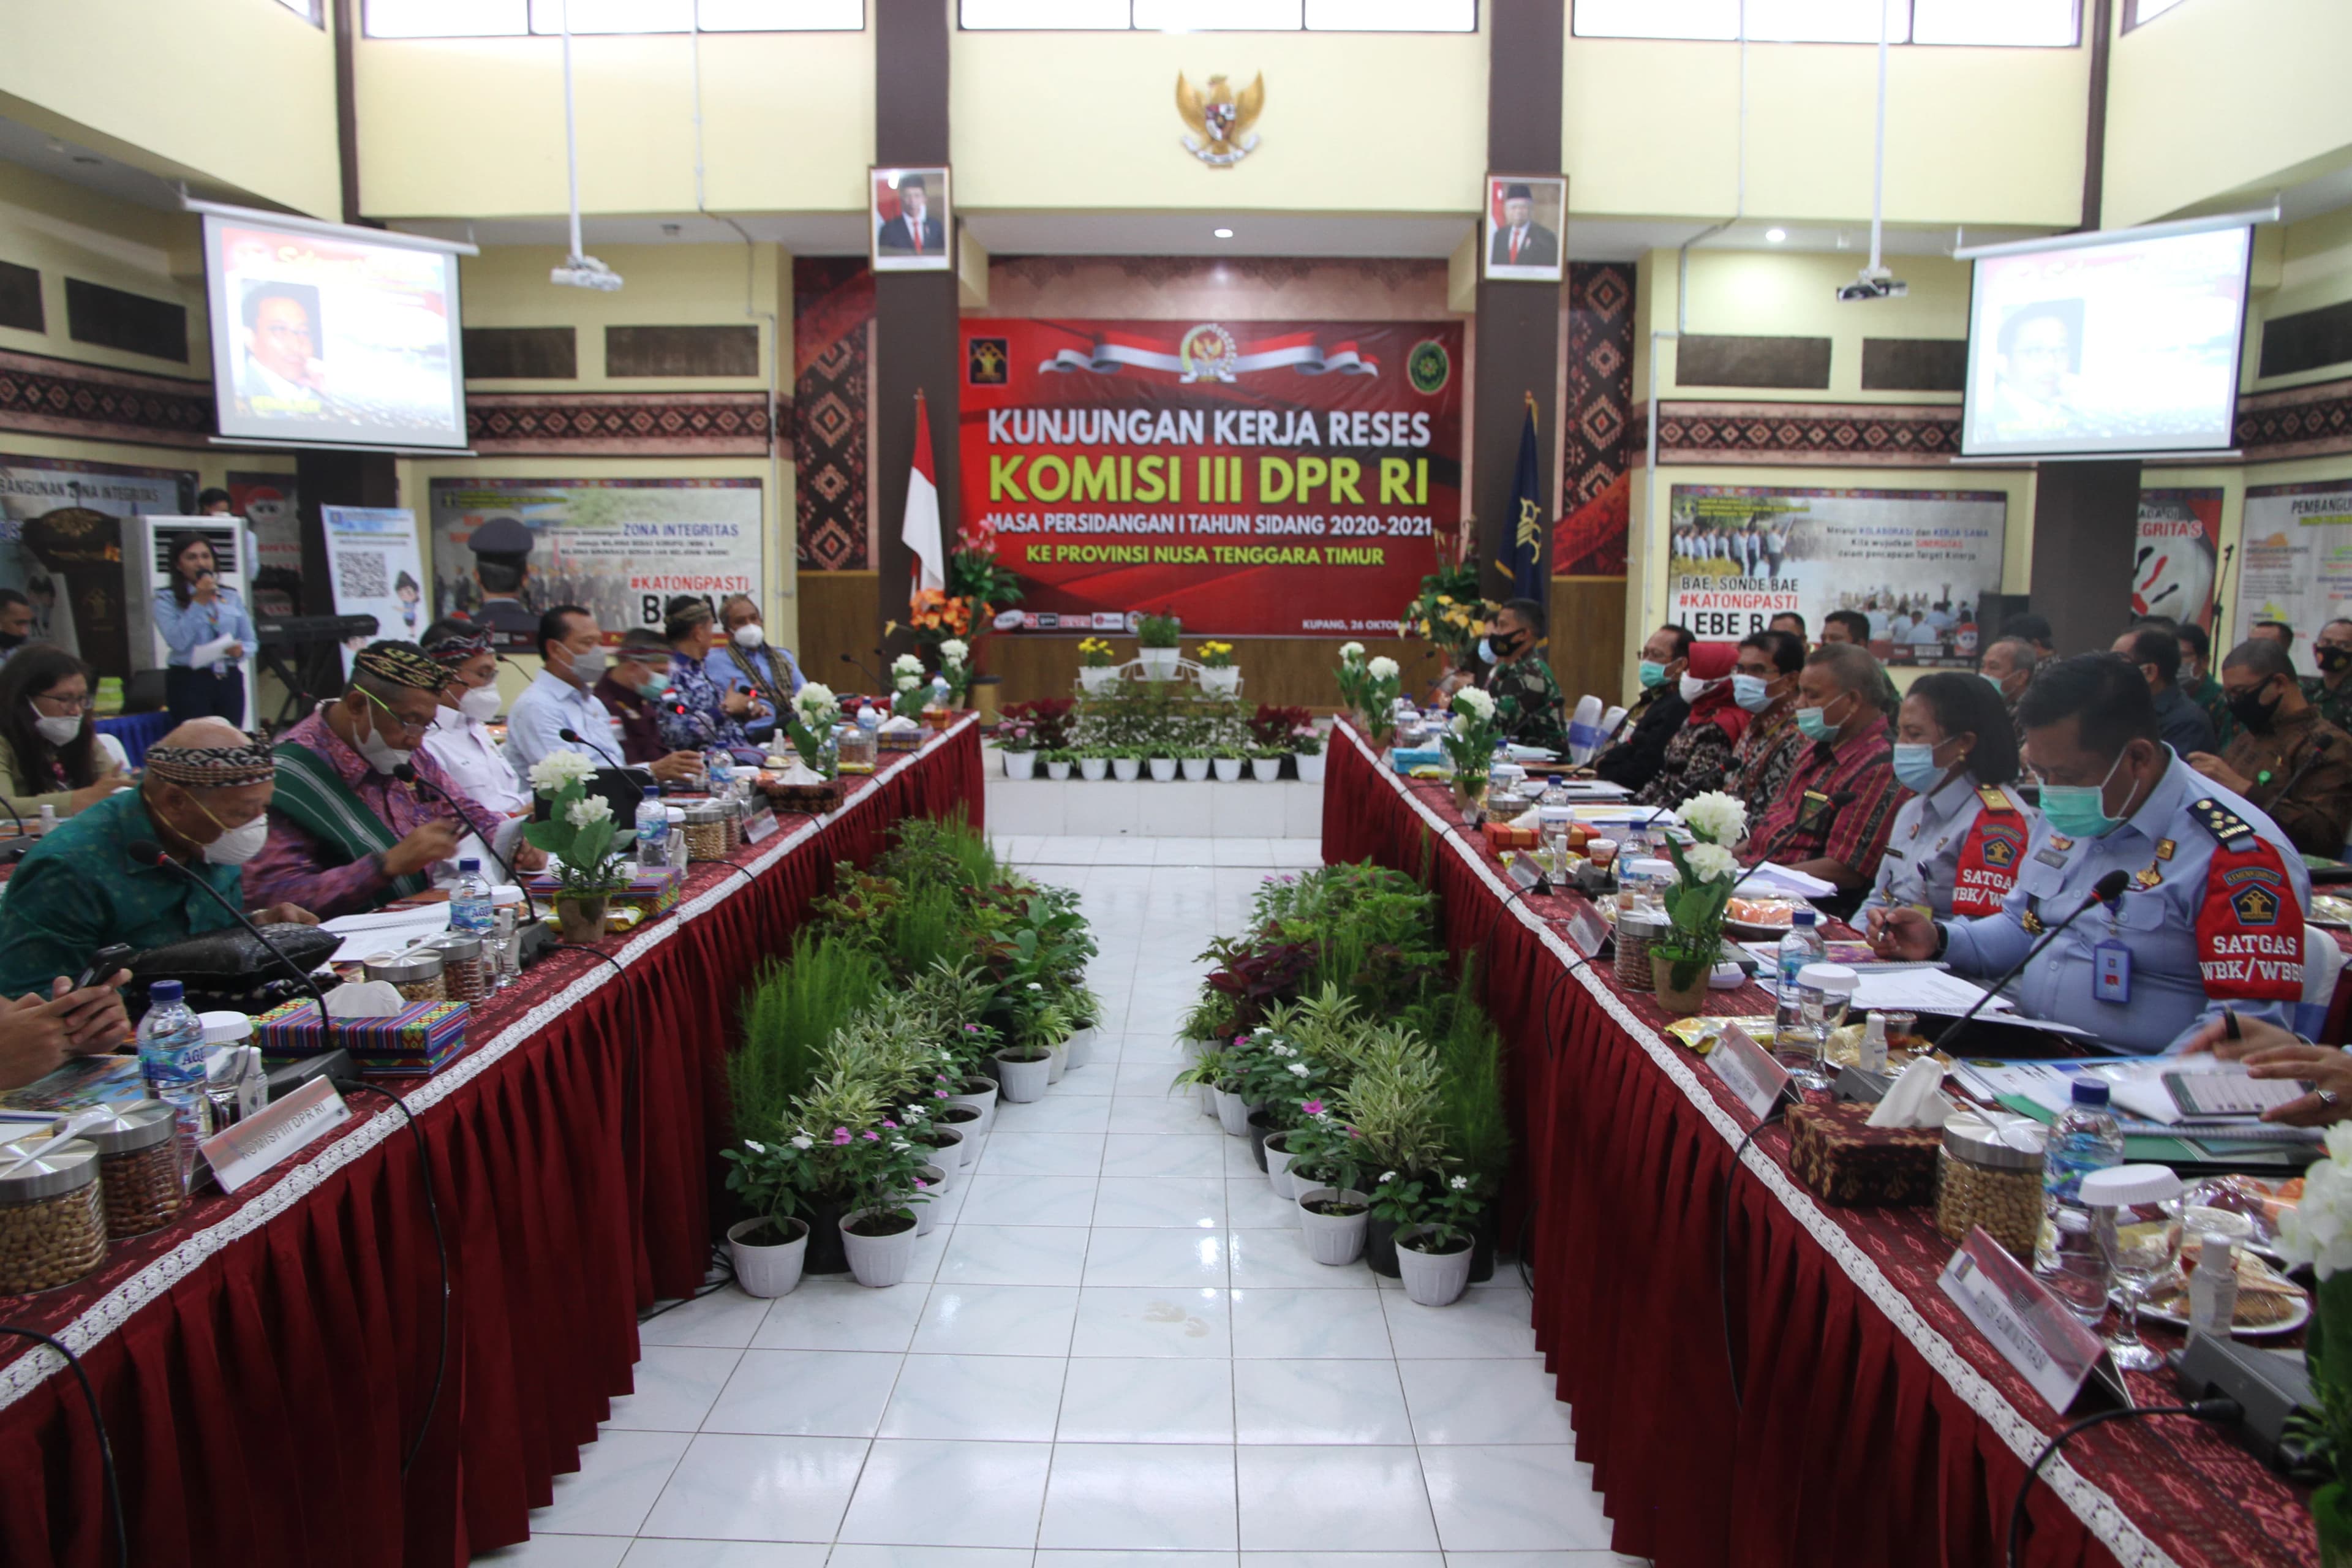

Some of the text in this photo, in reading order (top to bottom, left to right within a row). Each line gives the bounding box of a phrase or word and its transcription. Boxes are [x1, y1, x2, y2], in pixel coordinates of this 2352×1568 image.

[988, 409, 1431, 447] KUNJUNGAN KERJA RESES
[989, 454, 1428, 505] KOMISI III DPR RI
[624, 524, 658, 537] ZONA
[663, 524, 739, 537] INTEGRITAS
[986, 513, 1432, 536] MASA PERSIDANGAN I TAHUN SIDANG 2020-2021
[1027, 545, 1385, 565] KE PROVINSI NUSA TENGGARA TIMUR
[631, 576, 750, 591] #KATONGPASTI
[1682, 577, 1798, 592] BAE, SONDE BAE
[1679, 594, 1798, 609] #KATONGPASTI
[1365, 620, 1411, 631] OKTOBR
[2213, 935, 2296, 956] SATGAS
[2198, 957, 2303, 982] WBK/WBB
[292, 1108, 315, 1128] DPR
[313, 1102, 327, 1115] RI
